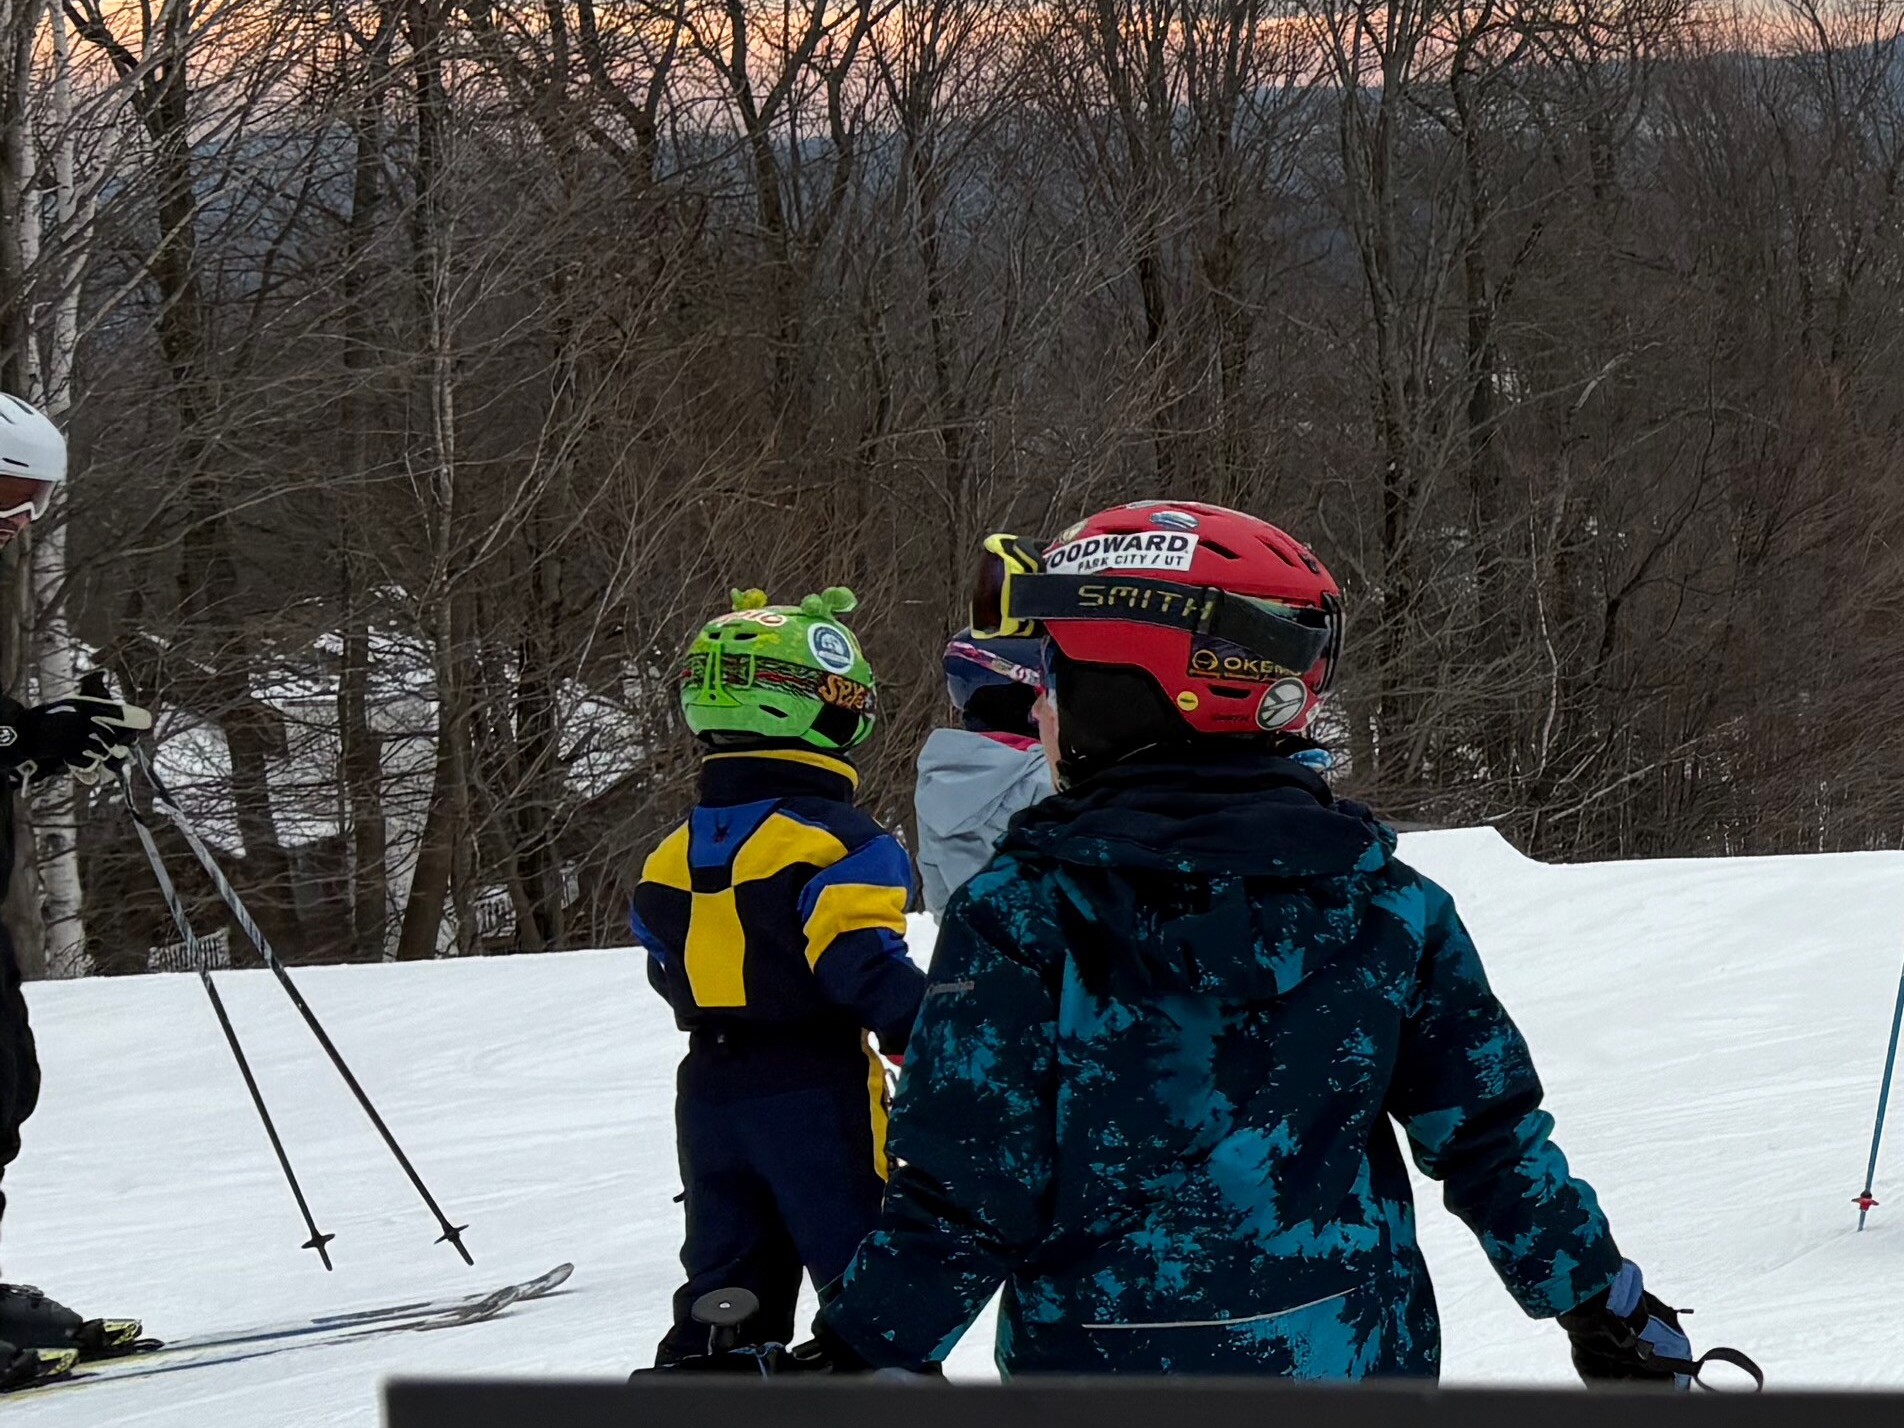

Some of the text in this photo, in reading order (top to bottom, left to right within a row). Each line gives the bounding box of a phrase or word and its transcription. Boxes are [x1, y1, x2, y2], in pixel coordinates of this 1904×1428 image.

[1049, 534, 1189, 568] OODWARD
[1078, 556, 1109, 572] PARK
[1114, 554, 1147, 565] CITY
[1164, 555, 1185, 567] UT
[1078, 584, 1217, 621] SMITH
